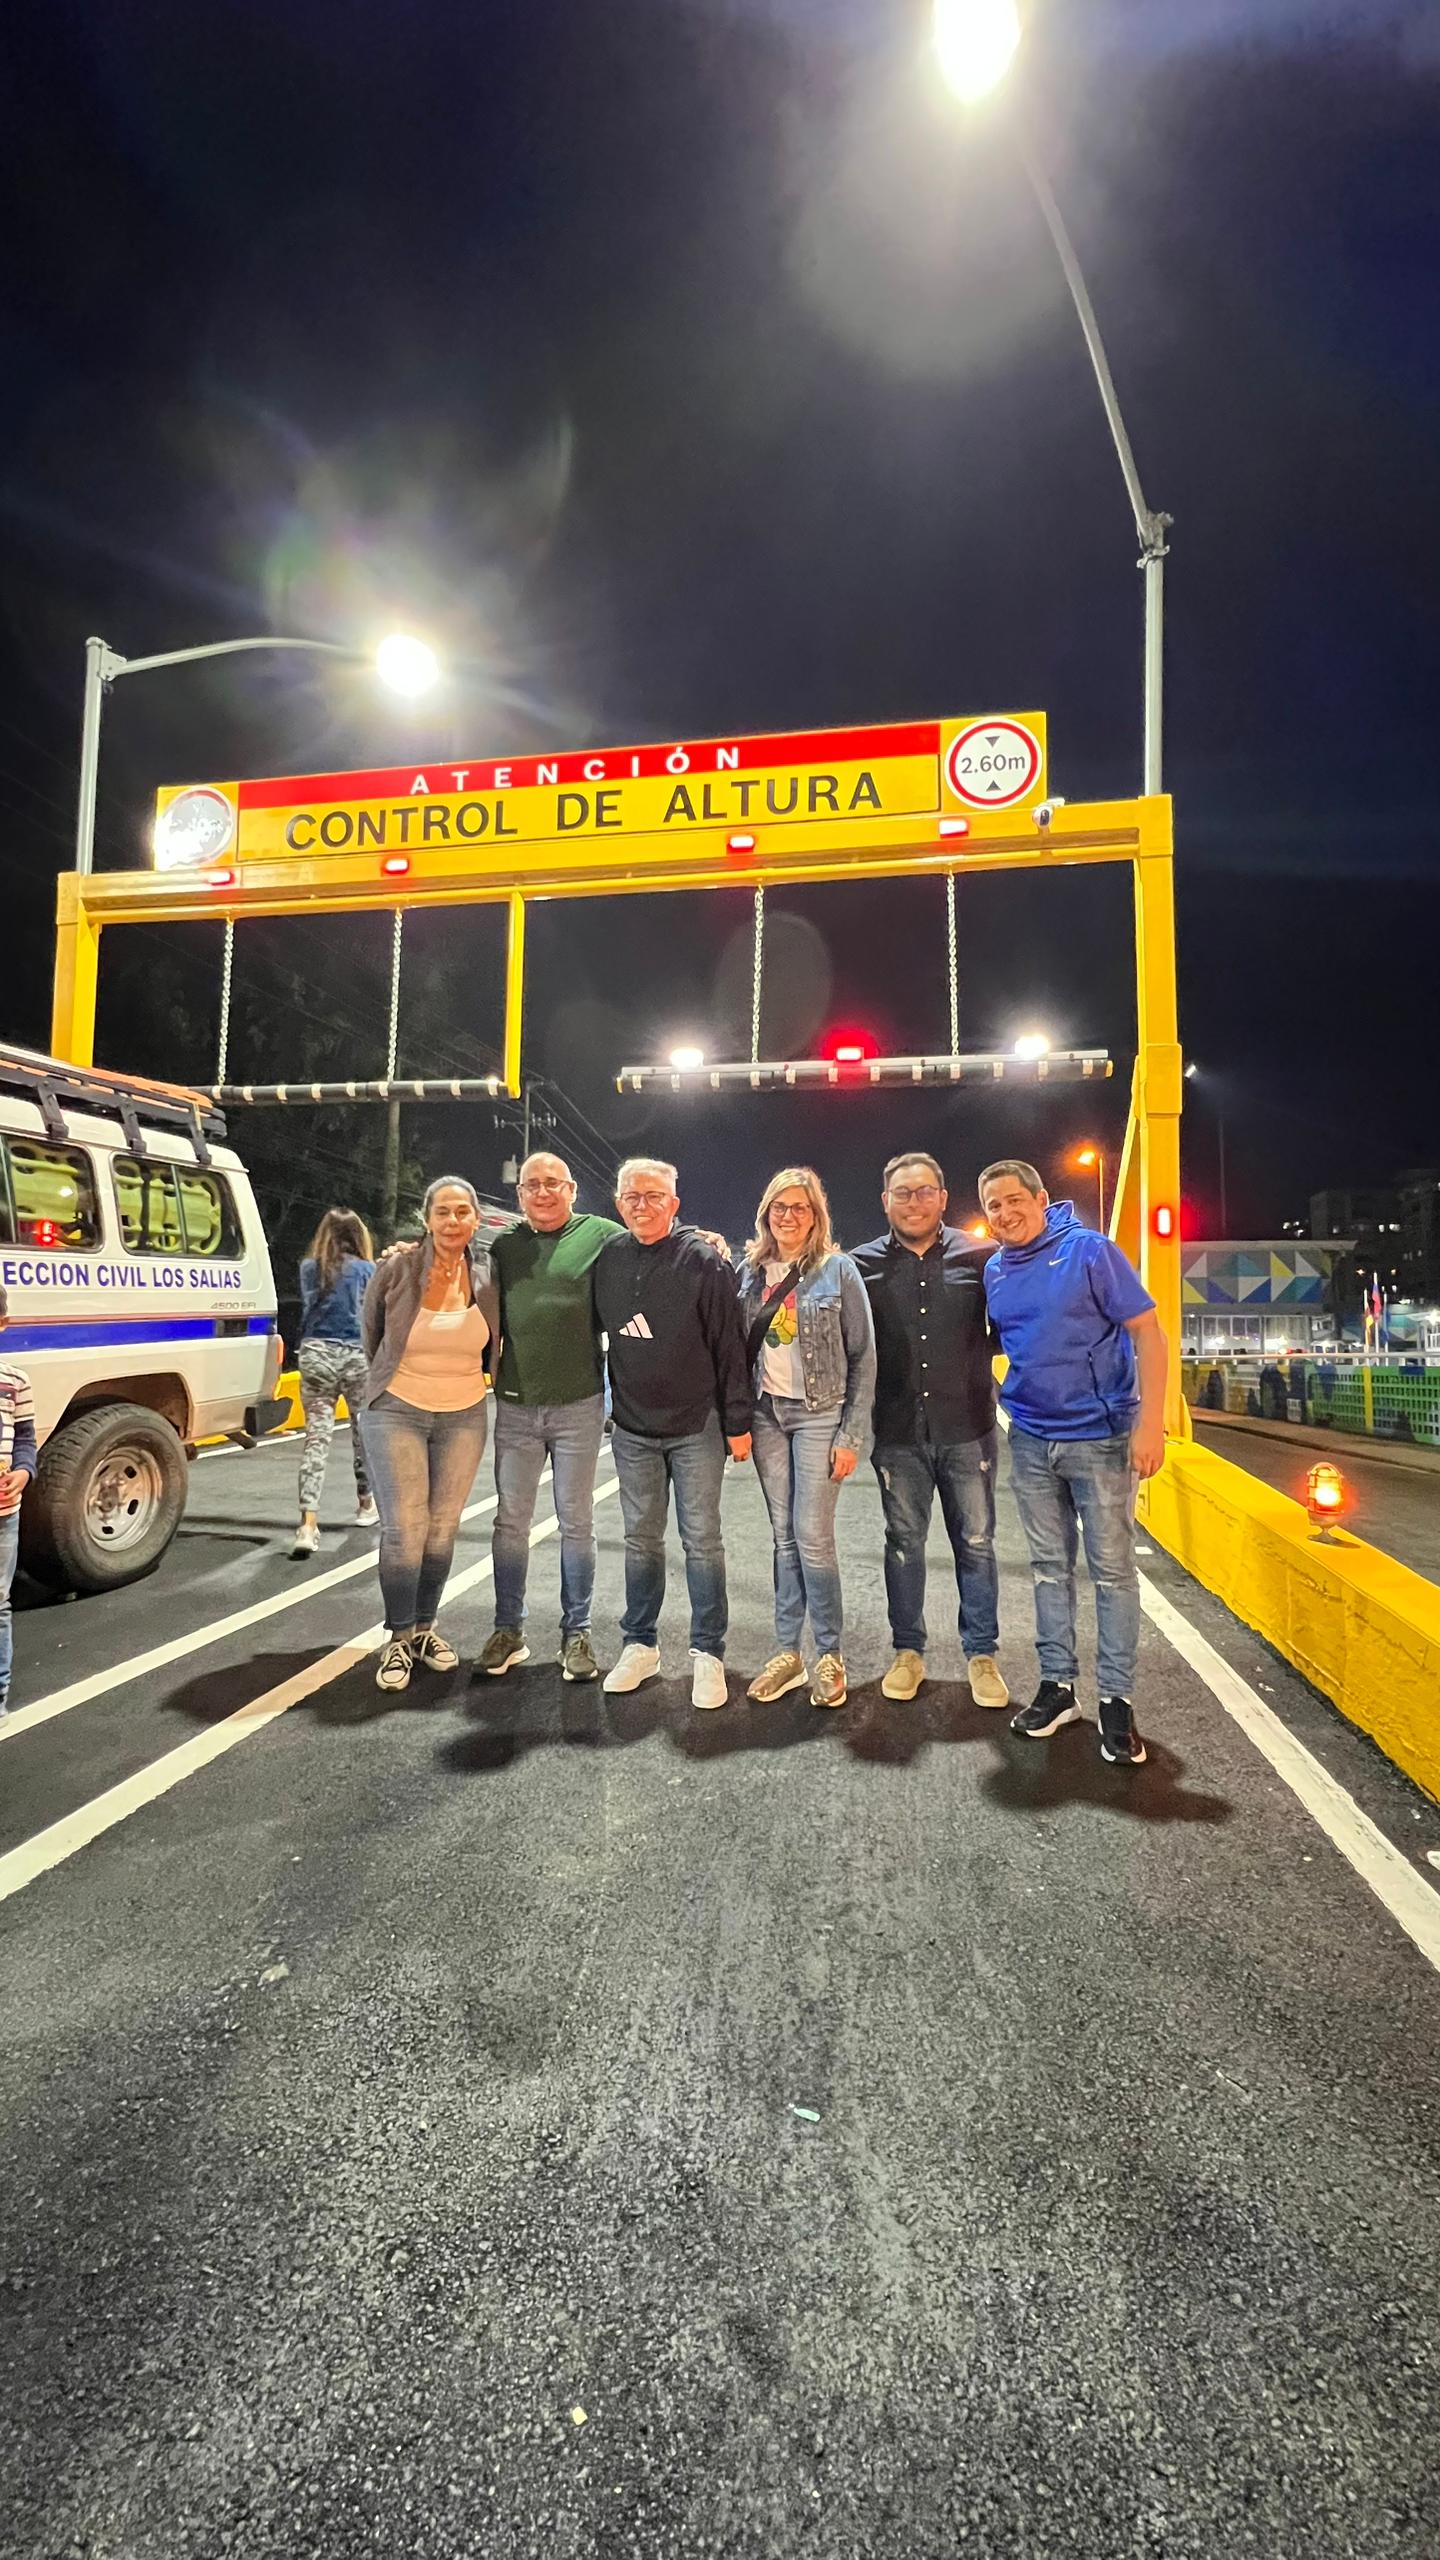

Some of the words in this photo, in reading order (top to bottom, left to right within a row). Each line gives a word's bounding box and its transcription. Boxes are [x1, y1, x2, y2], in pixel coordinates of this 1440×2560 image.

[410, 745, 740, 795] ATENCIÓN
[961, 752, 1026, 774] 2.60m
[286, 801, 518, 851] CONTROL
[556, 789, 623, 831] DE
[663, 771, 883, 823] ALTURA
[97, 1265, 147, 1287] CIVIL
[152, 1267, 185, 1288] LOS
[190, 1268, 241, 1288] SALIAS
[210, 1301, 240, 1310] 4500
